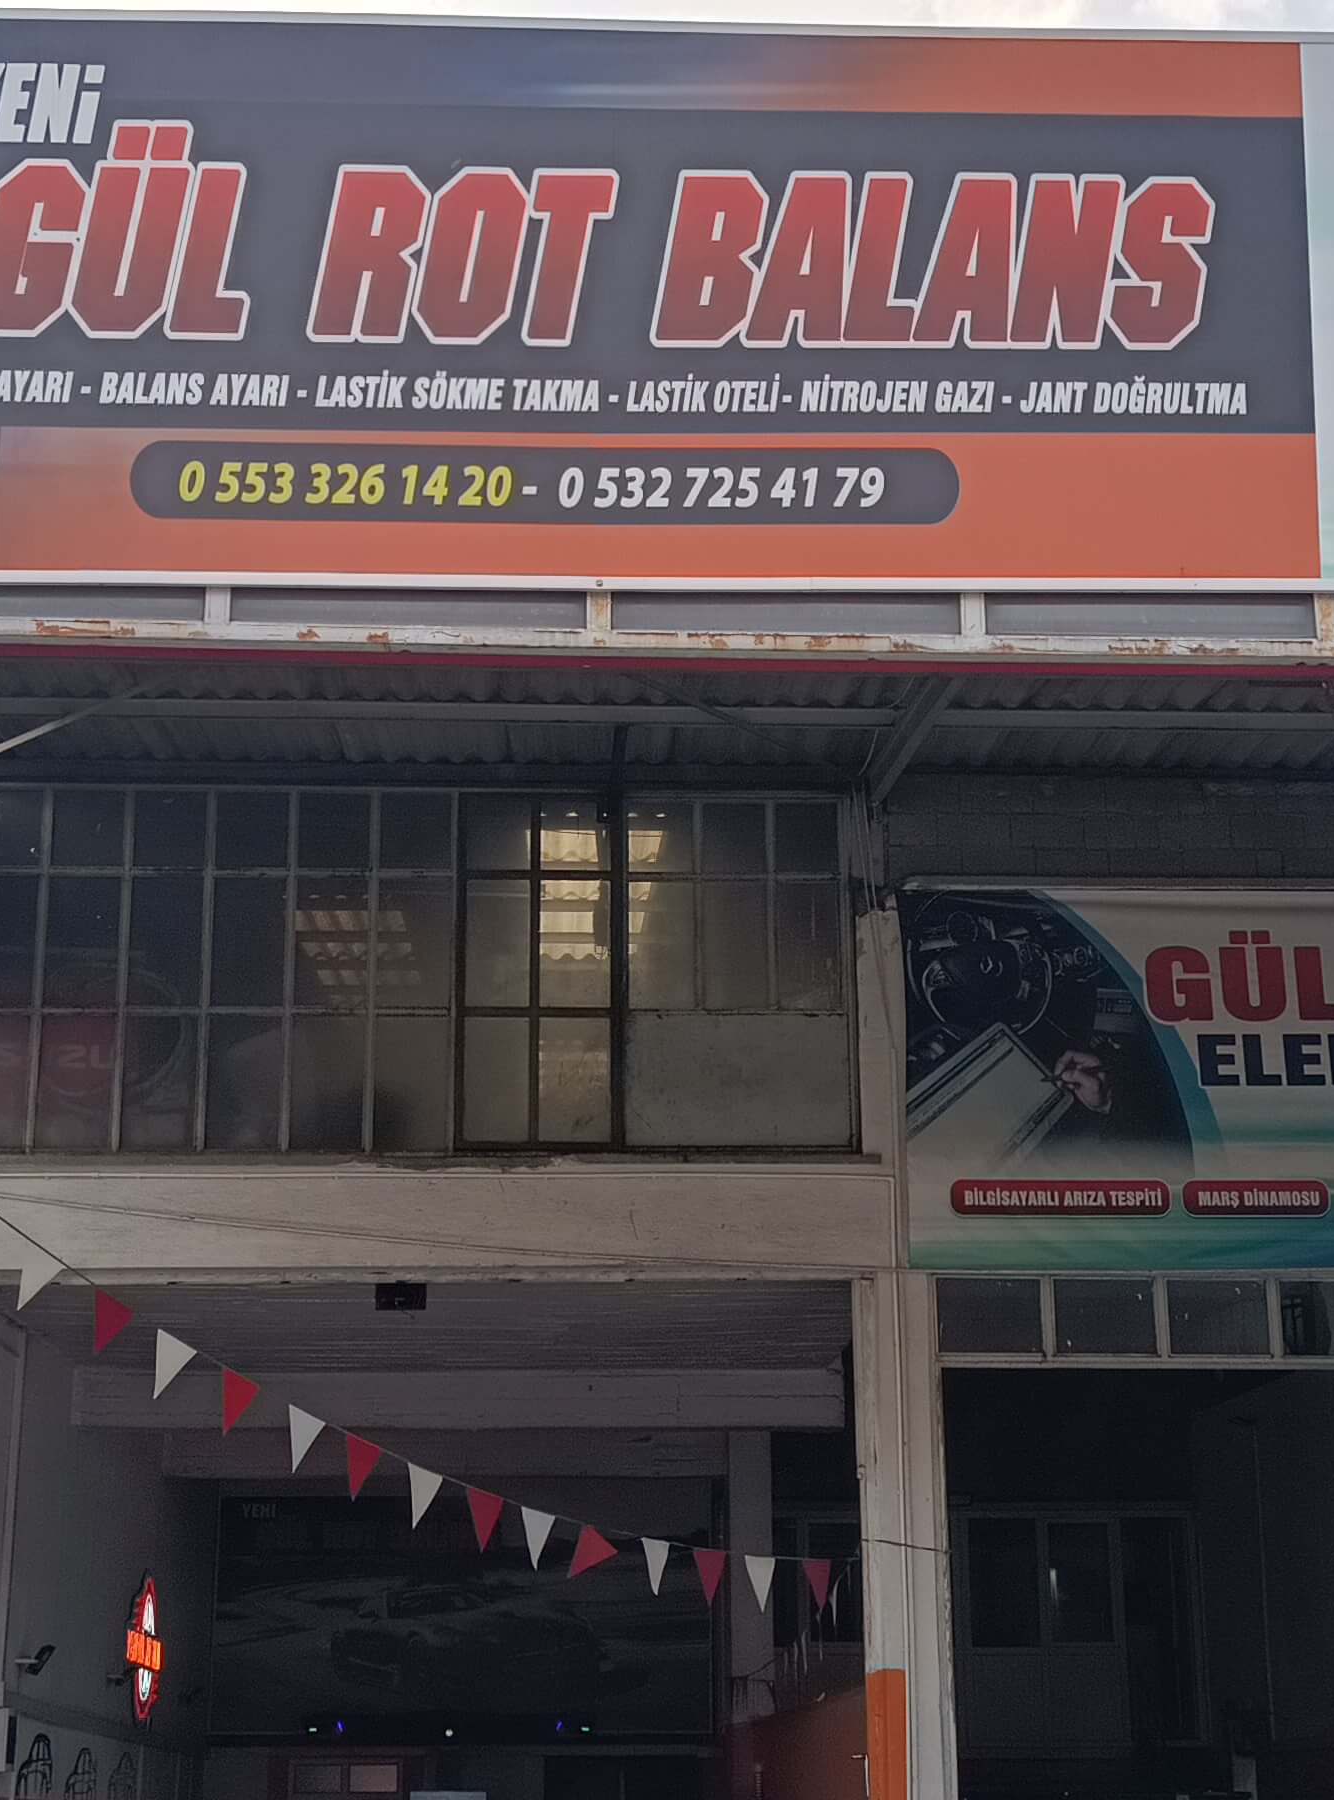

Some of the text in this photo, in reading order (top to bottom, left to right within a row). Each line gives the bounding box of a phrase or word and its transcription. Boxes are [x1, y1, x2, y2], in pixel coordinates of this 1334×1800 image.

[305, 163, 620, 347] ROT
[649, 169, 1216, 351] BALANS
[98, 371, 205, 407] BALANS
[209, 373, 292, 408] AYARI
[315, 369, 406, 410] LASTİK
[411, 372, 505, 412] SÖKME
[512, 379, 600, 414] TAKMA
[625, 372, 708, 414] LASTİK
[798, 373, 928, 415] NİTROJEN
[934, 380, 995, 415] GAZI
[1018, 380, 1088, 415] JANT
[1092, 374, 1248, 416] DOĞRULTMA
[178, 460, 206, 504] 0
[214, 461, 295, 504] 553
[304, 462, 386, 506] 326
[402, 465, 448, 507] 14
[457, 465, 513, 508] 20
[558, 468, 585, 509] 0
[593, 466, 671, 510] 532
[683, 467, 760, 510] 725
[770, 468, 819, 509] 41
[833, 467, 886, 509] 79
[964, 1186, 1163, 1207] BİLGİSAYARLI ARIZA TESPİTİ
[1198, 1187, 1320, 1210] MARŞ DİNAMOSU
